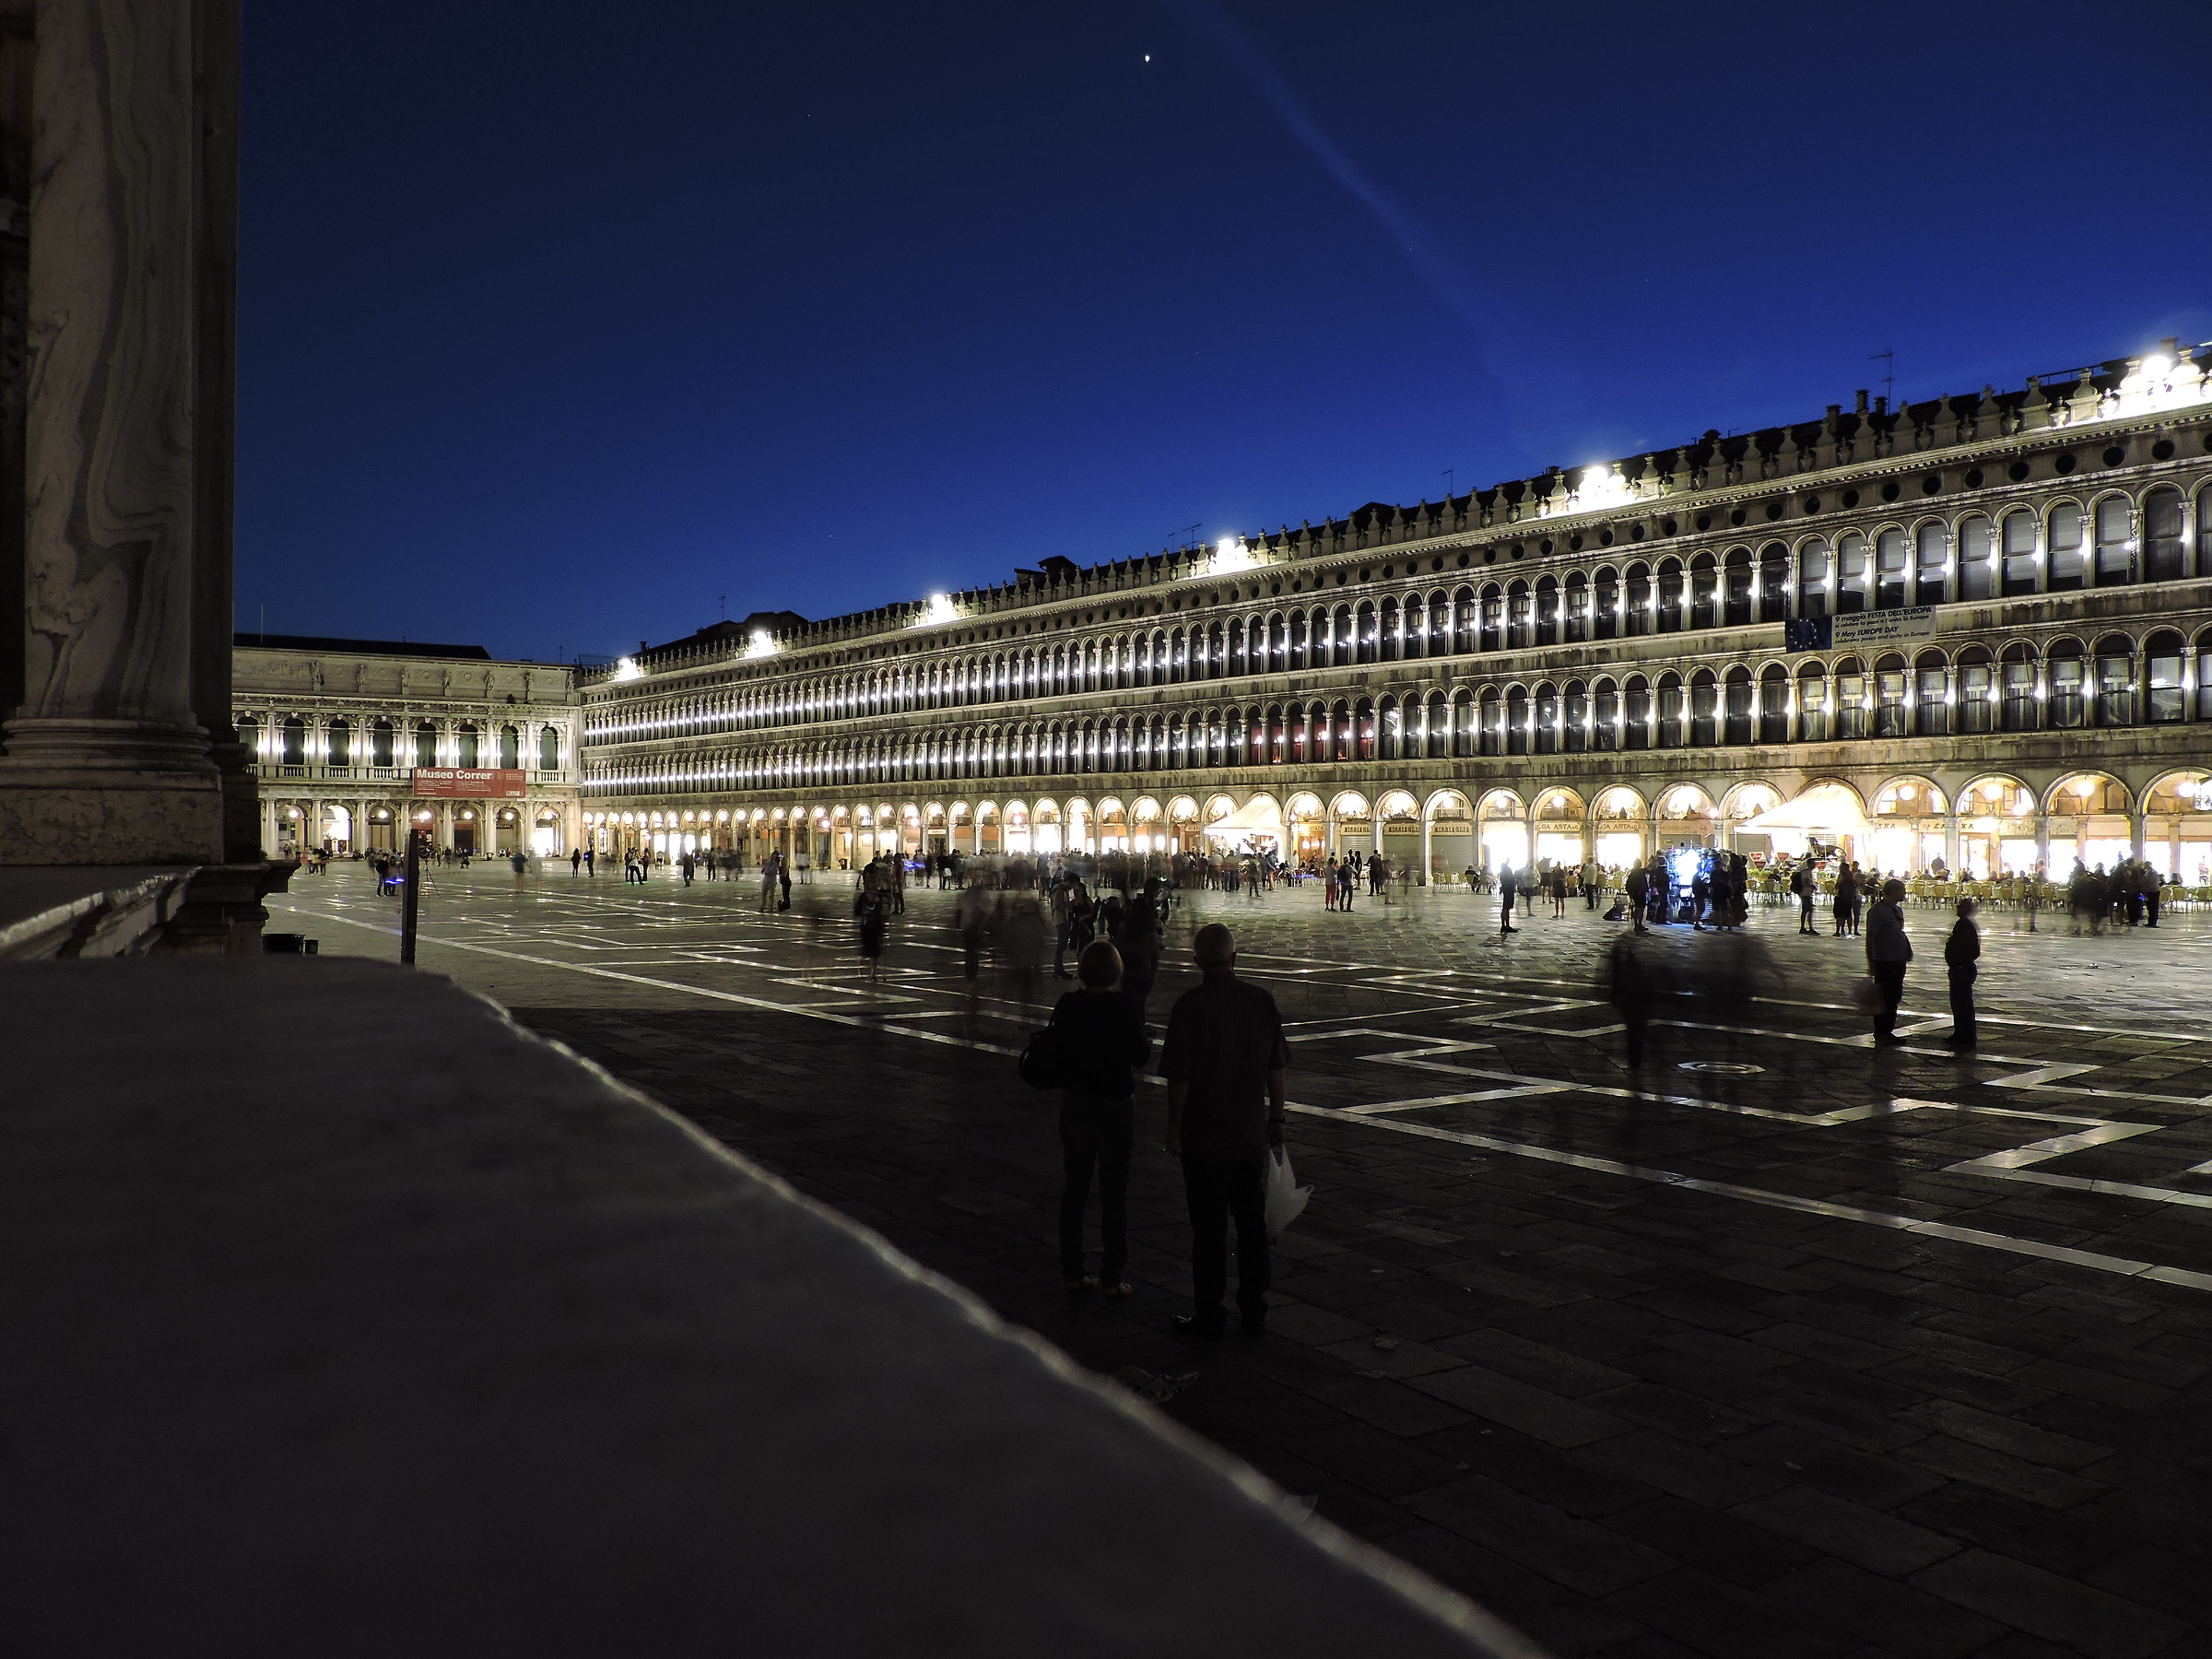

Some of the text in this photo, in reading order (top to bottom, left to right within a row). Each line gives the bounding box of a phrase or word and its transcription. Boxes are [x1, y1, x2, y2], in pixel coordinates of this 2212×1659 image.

[1841, 614, 1865, 622] maggio
[1867, 611, 1886, 619] FESTA
[1888, 606, 1932, 617] DELL'EUROPA
[1857, 627, 1883, 635] EUROPE
[417, 769, 492, 780] Museo Correr
